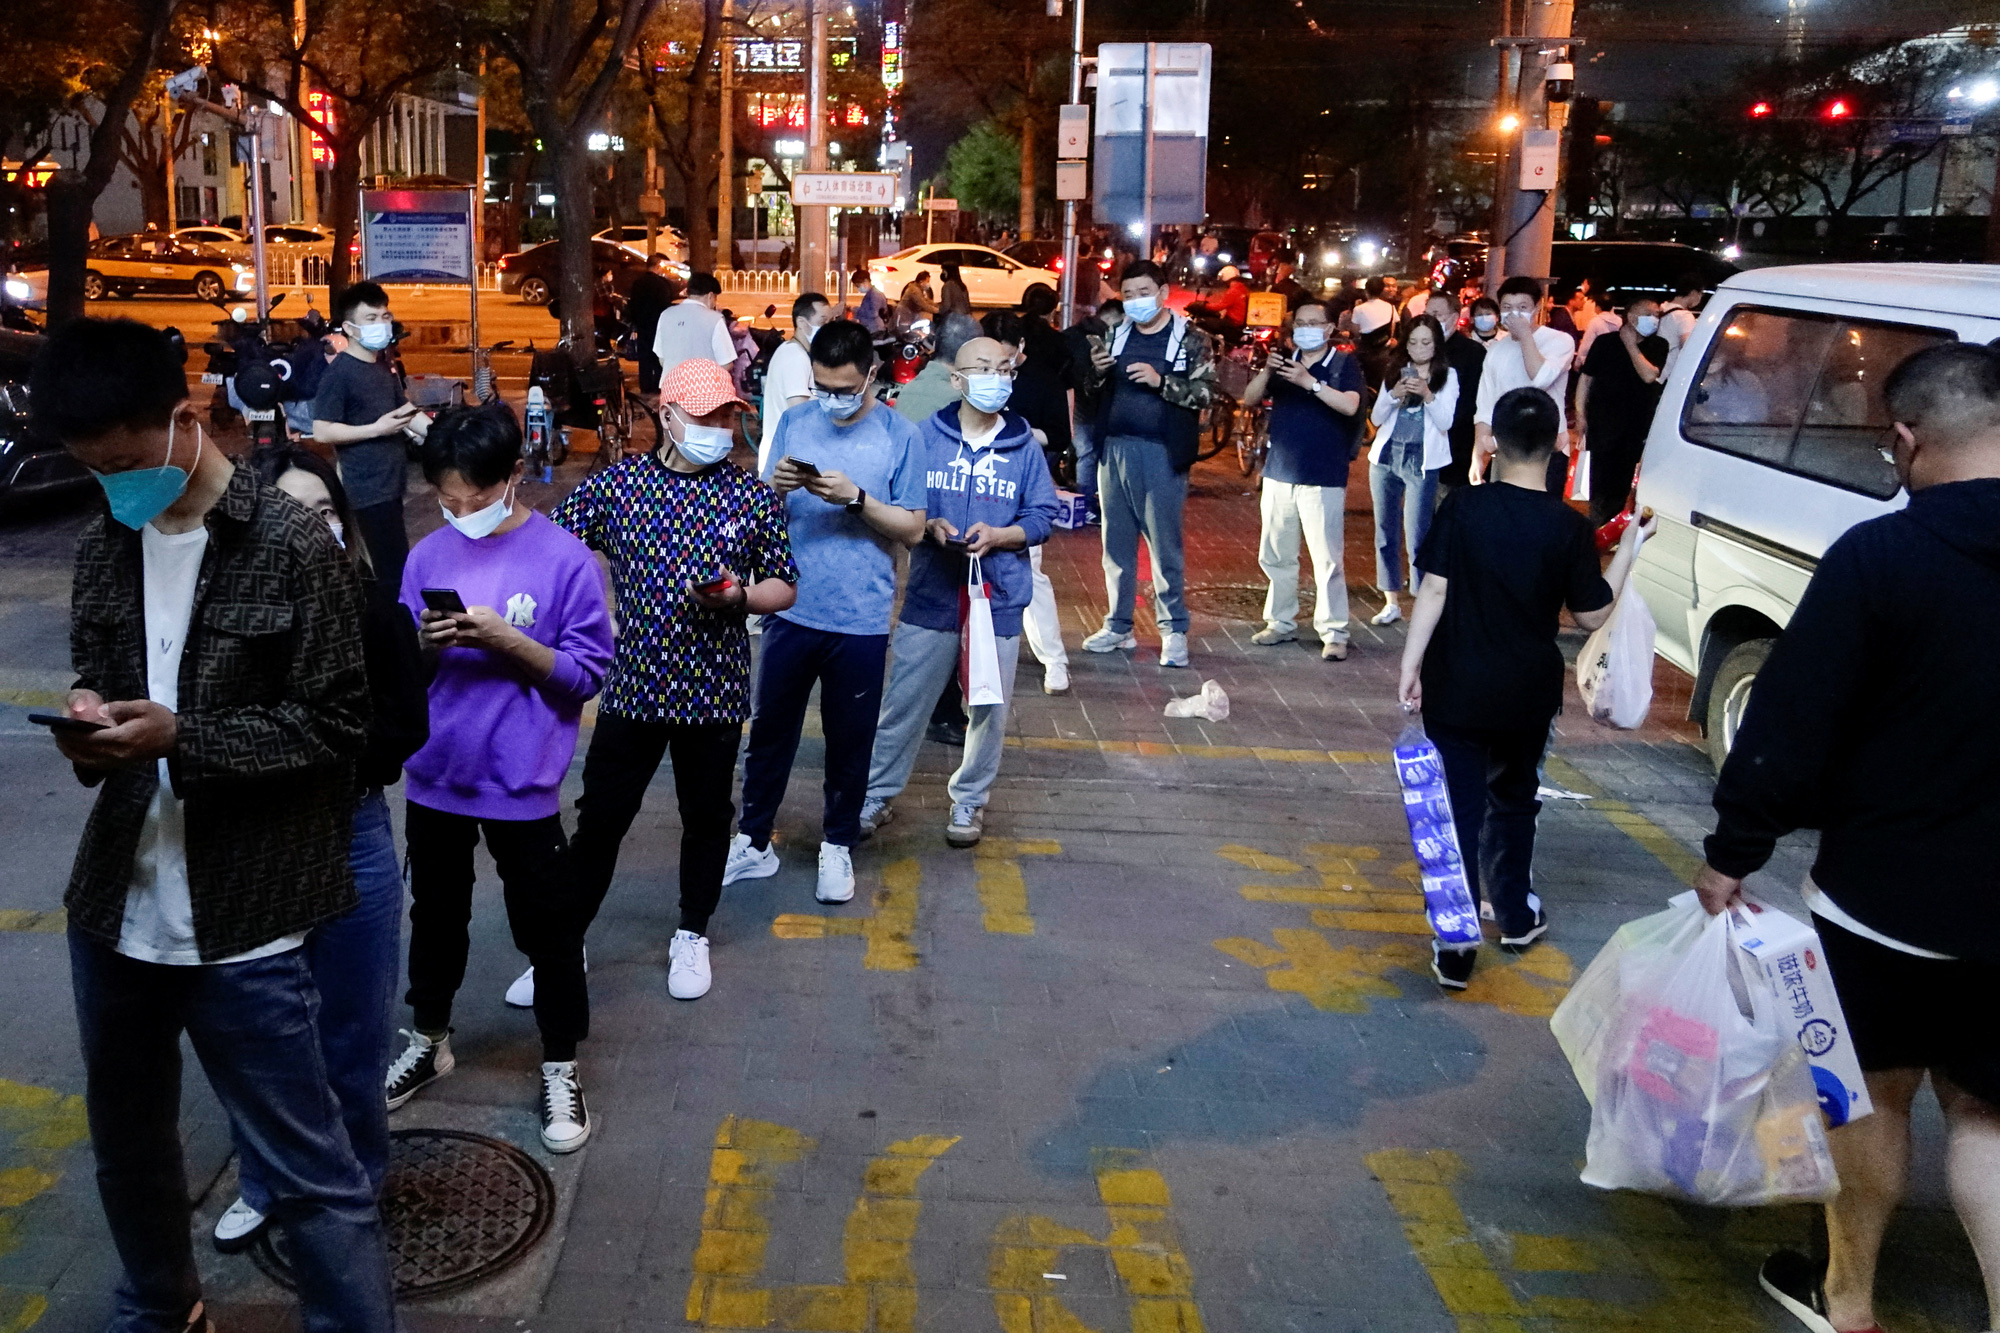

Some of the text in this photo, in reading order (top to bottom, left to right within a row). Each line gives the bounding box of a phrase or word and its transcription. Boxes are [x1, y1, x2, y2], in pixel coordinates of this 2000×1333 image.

[832, 53, 850, 66] 3F
[815, 180, 872, 193] 工人体育场北路
[504, 592, 538, 628] NY
